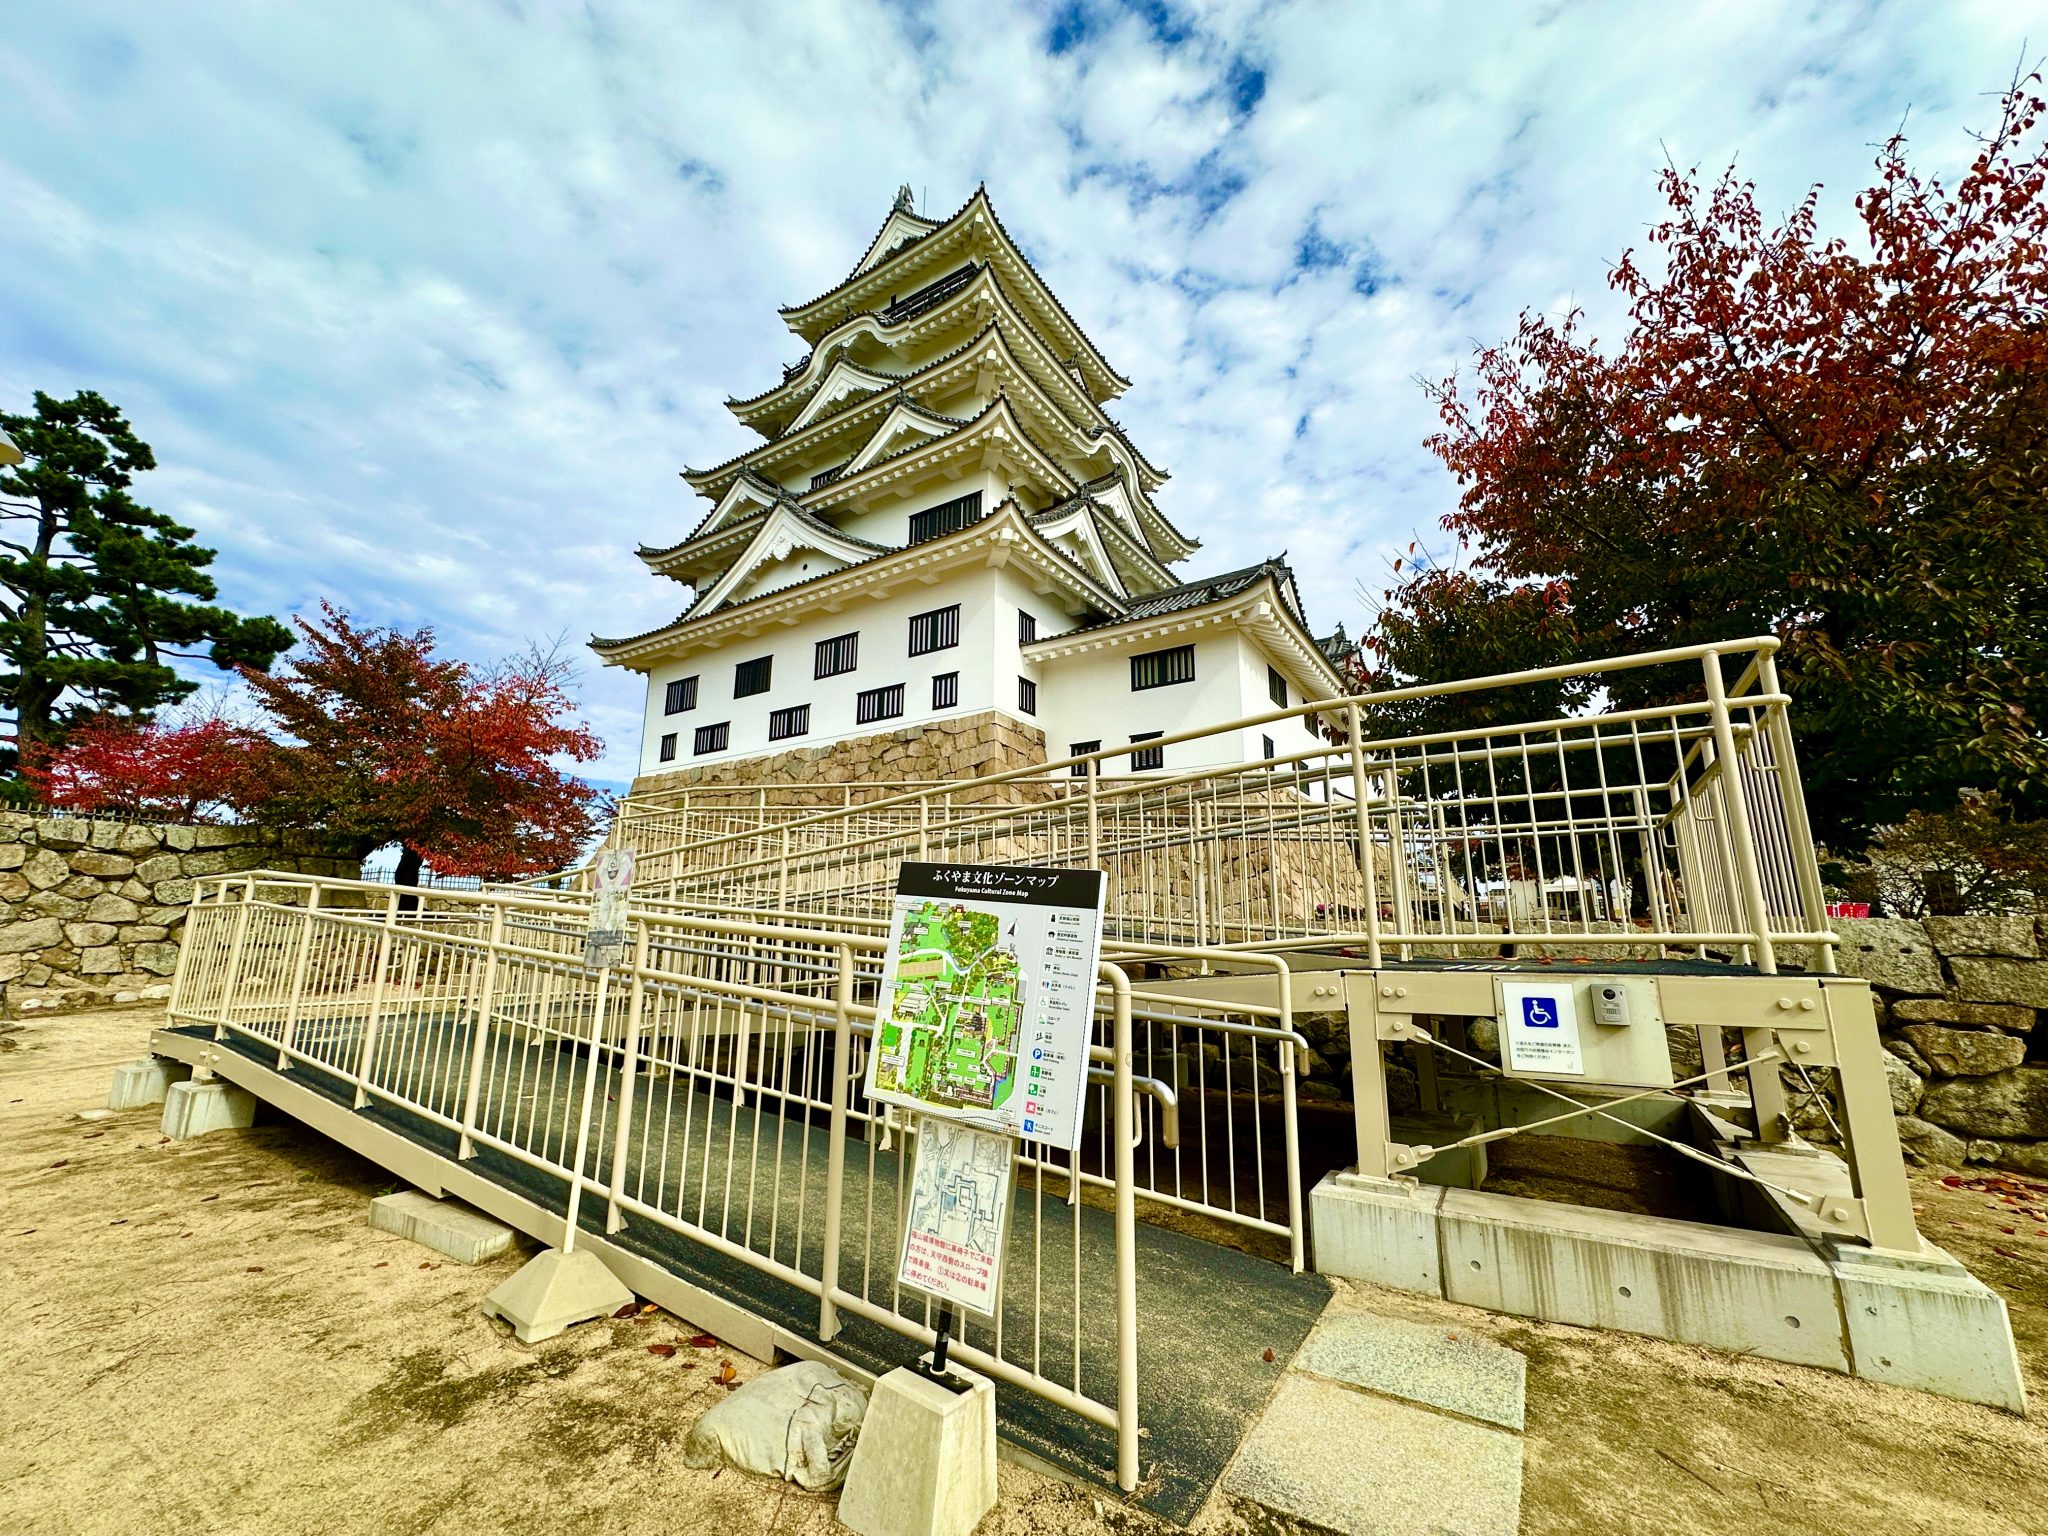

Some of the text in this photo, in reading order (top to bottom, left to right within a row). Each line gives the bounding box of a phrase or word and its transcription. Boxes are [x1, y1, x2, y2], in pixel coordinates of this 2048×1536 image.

[932, 869, 1060, 888] ふくやま文化ゾーンマップ
[954, 885, 1029, 898] Fukuyama Cultural Zone Map
[911, 1230, 993, 1266] 福山城博物館に車椅子でご来館
[905, 1268, 949, 1291] に停めてください。
